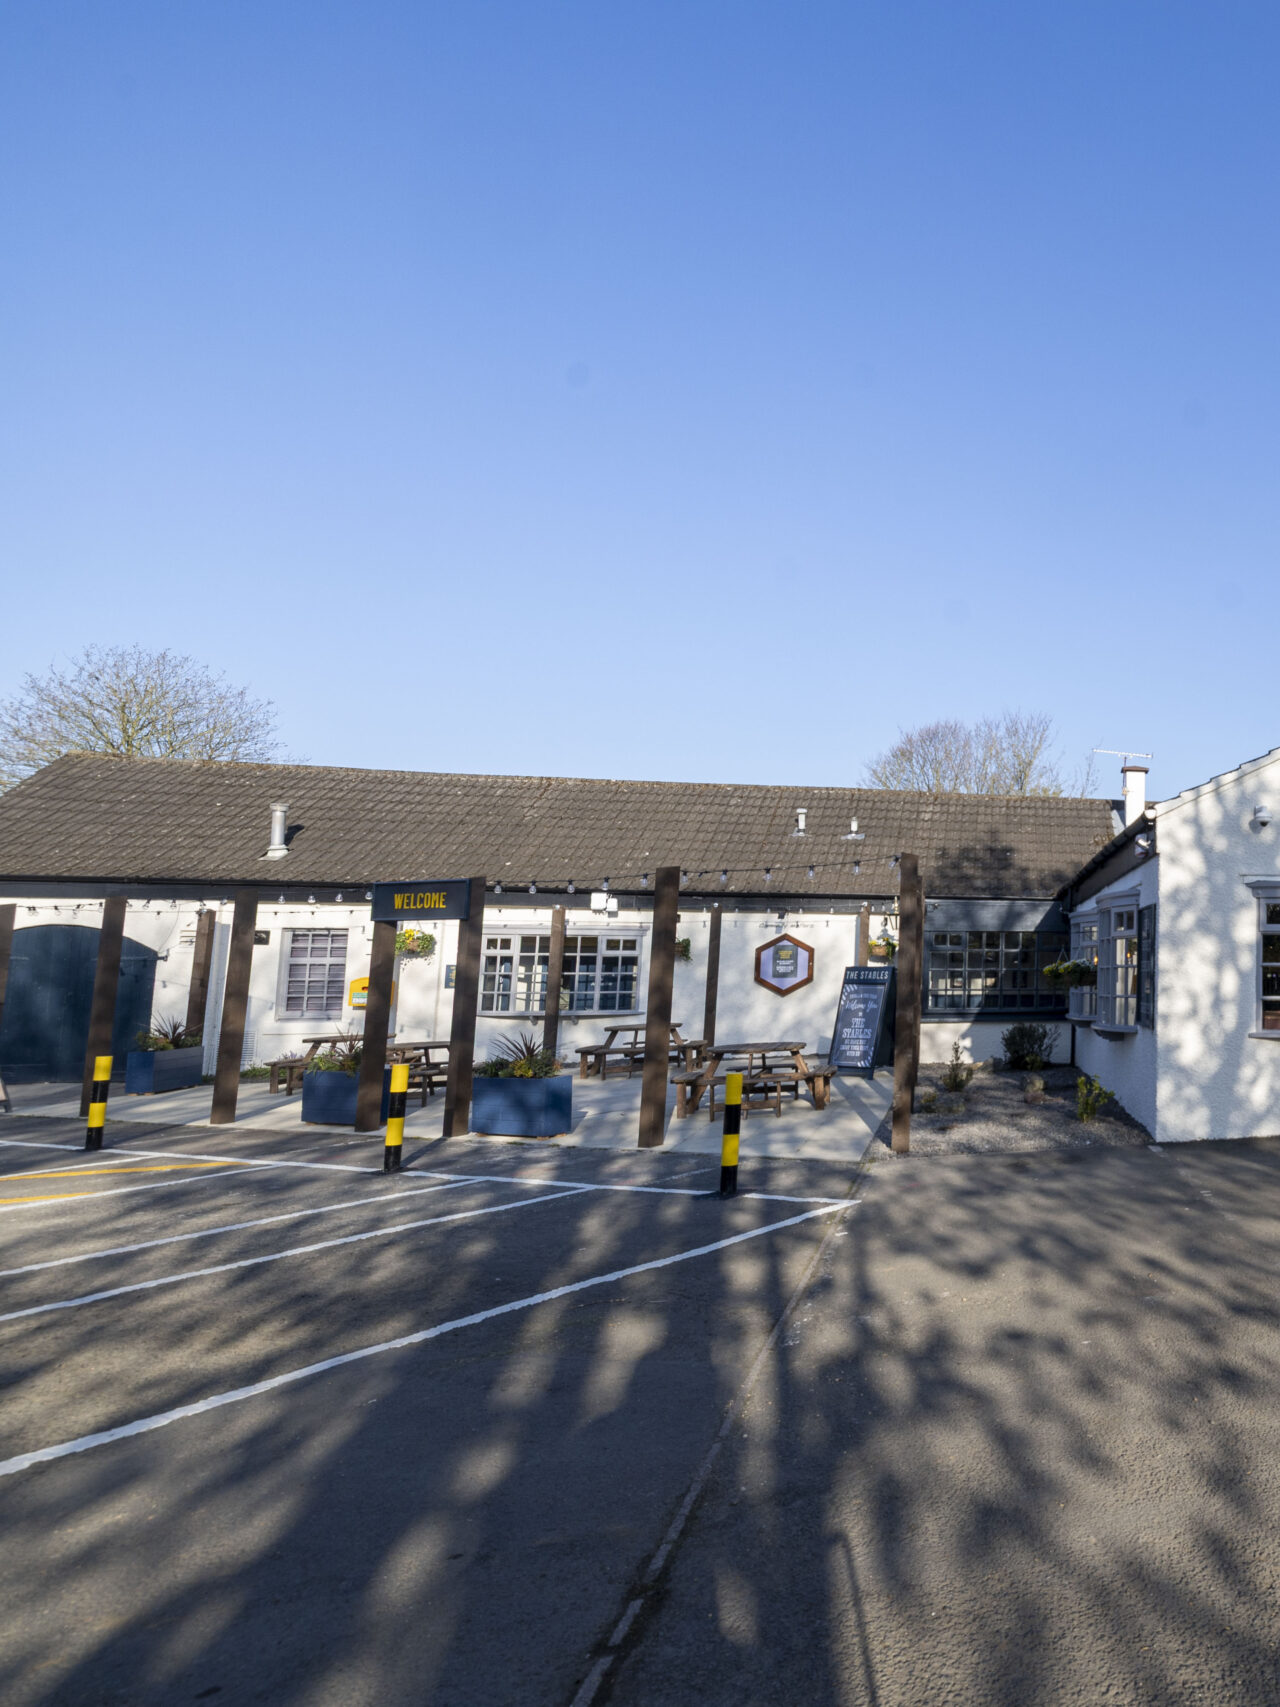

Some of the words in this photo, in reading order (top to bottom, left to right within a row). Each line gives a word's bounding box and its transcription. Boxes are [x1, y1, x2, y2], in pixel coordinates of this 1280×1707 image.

[394, 892, 447, 909] WELCOME
[846, 970, 858, 979] THE
[860, 970, 889, 979] STABLES
